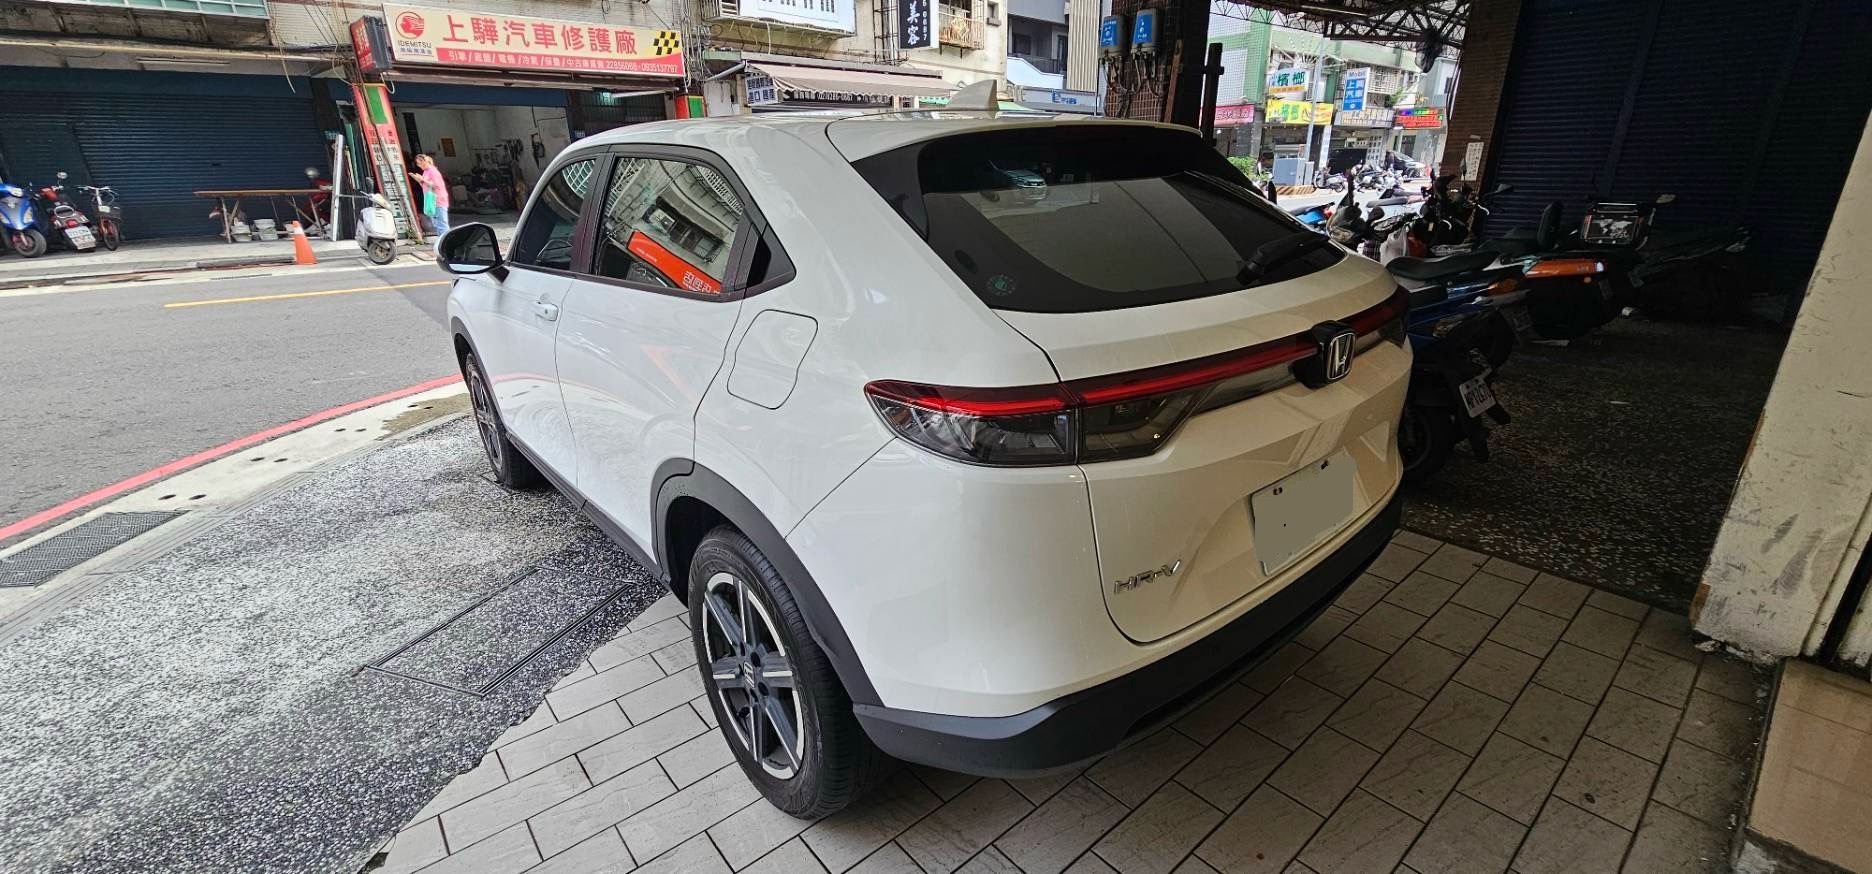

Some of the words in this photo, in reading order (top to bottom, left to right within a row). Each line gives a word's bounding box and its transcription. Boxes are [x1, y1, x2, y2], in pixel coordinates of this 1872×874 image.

[397, 40, 432, 49] IDEMITSU
[442, 14, 638, 55] 上驊汽車修護廠
[1114, 559, 1181, 595] HR-V
